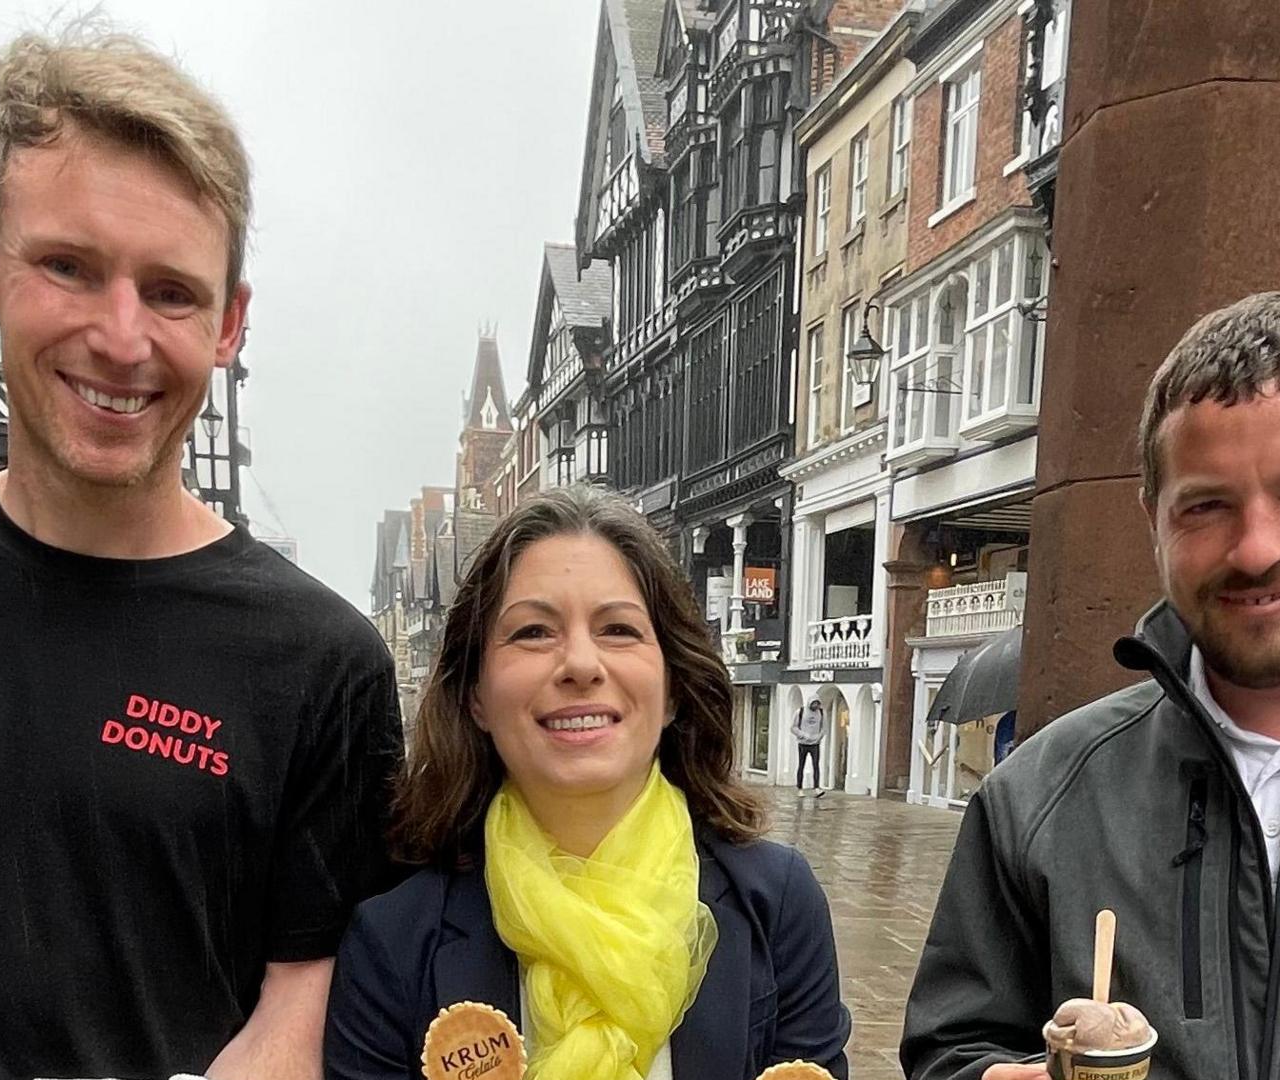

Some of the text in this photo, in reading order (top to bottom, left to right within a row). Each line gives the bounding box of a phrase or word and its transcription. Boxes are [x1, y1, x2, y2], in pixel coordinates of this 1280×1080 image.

[746, 578, 770, 588] LAKE
[746, 588, 774, 599] LAND
[126, 694, 222, 740] DIDDY
[102, 719, 229, 776] DONUTS
[441, 1032, 510, 1072] KRUM
